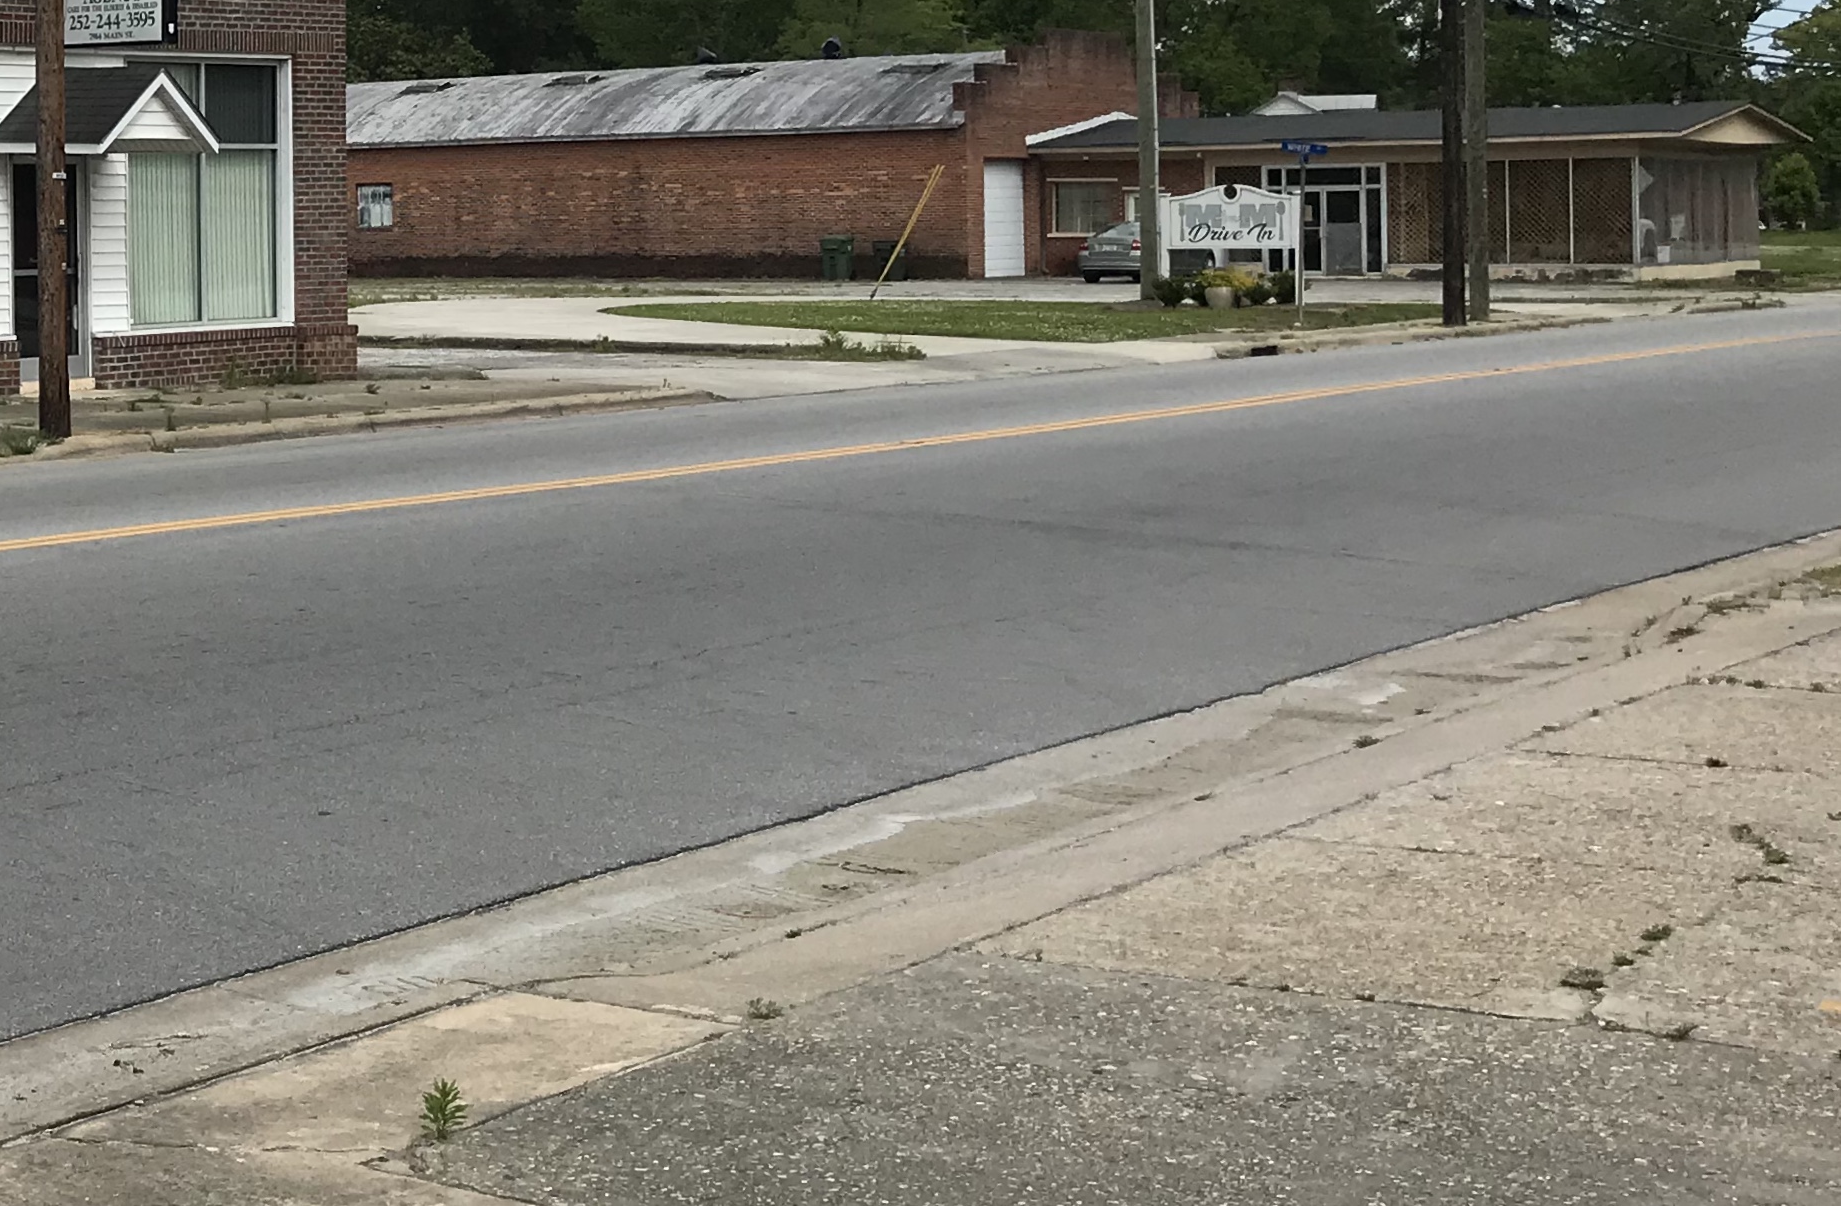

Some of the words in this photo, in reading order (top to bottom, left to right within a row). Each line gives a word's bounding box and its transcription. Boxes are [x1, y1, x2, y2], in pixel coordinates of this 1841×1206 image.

[69, 10, 156, 30] 252-244-3595
[1188, 222, 1244, 243] Drive
[1246, 222, 1276, 243] In
